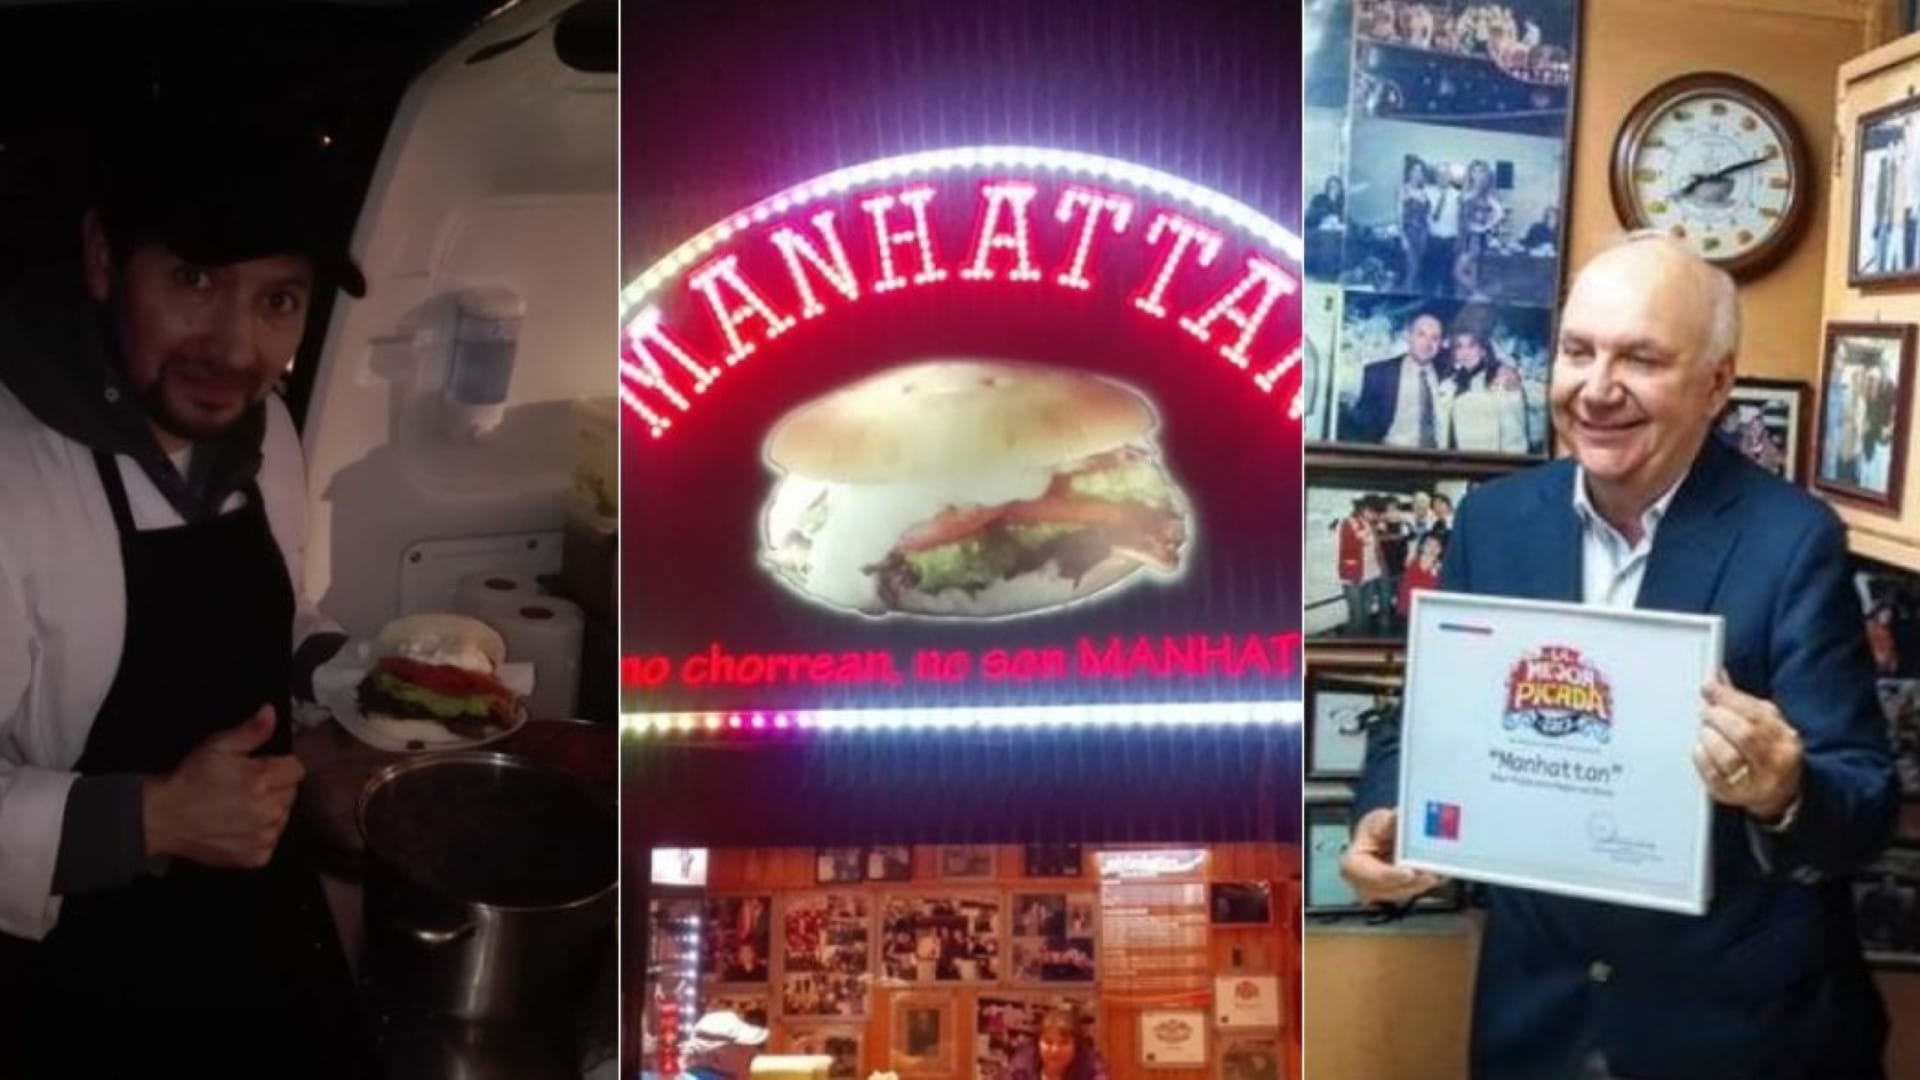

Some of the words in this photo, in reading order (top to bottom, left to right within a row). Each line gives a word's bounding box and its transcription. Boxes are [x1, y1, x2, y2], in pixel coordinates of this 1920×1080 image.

[680, 642, 903, 686] chorrean,
[1078, 633, 1302, 678] MANHAT
[1514, 681, 1607, 721] PICADA
